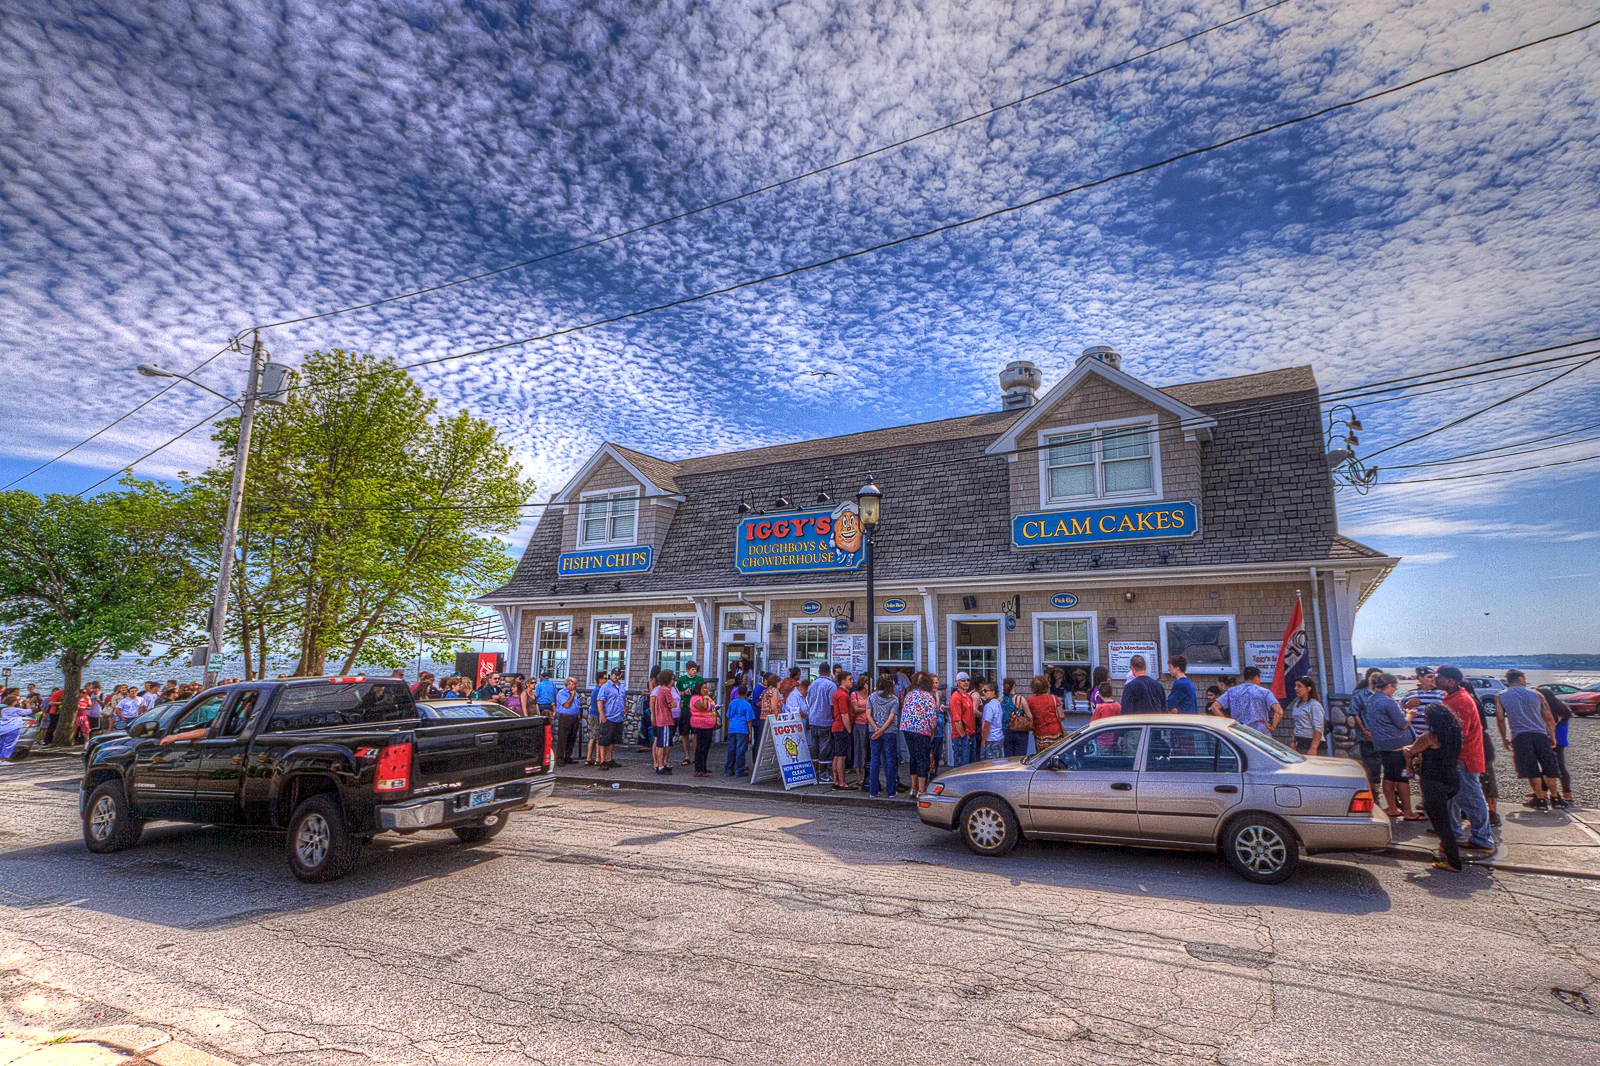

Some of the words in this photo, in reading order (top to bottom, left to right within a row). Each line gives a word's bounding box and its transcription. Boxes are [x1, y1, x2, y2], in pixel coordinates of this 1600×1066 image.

[745, 517, 832, 541] IGGY'S
[1022, 517, 1093, 539] CLAM
[1098, 509, 1185, 534] CAKES
[748, 541, 816, 556] DOUGHBOYS
[818, 540, 828, 551] &
[562, 555, 603, 571] FISH'N
[605, 551, 647, 568] CHIPS
[741, 552, 835, 568] CHOWDERHOUSE
[1252, 655, 1271, 663] Iggy's
[773, 724, 803, 736] IGGY'S
[794, 762, 811, 770] SERVING
